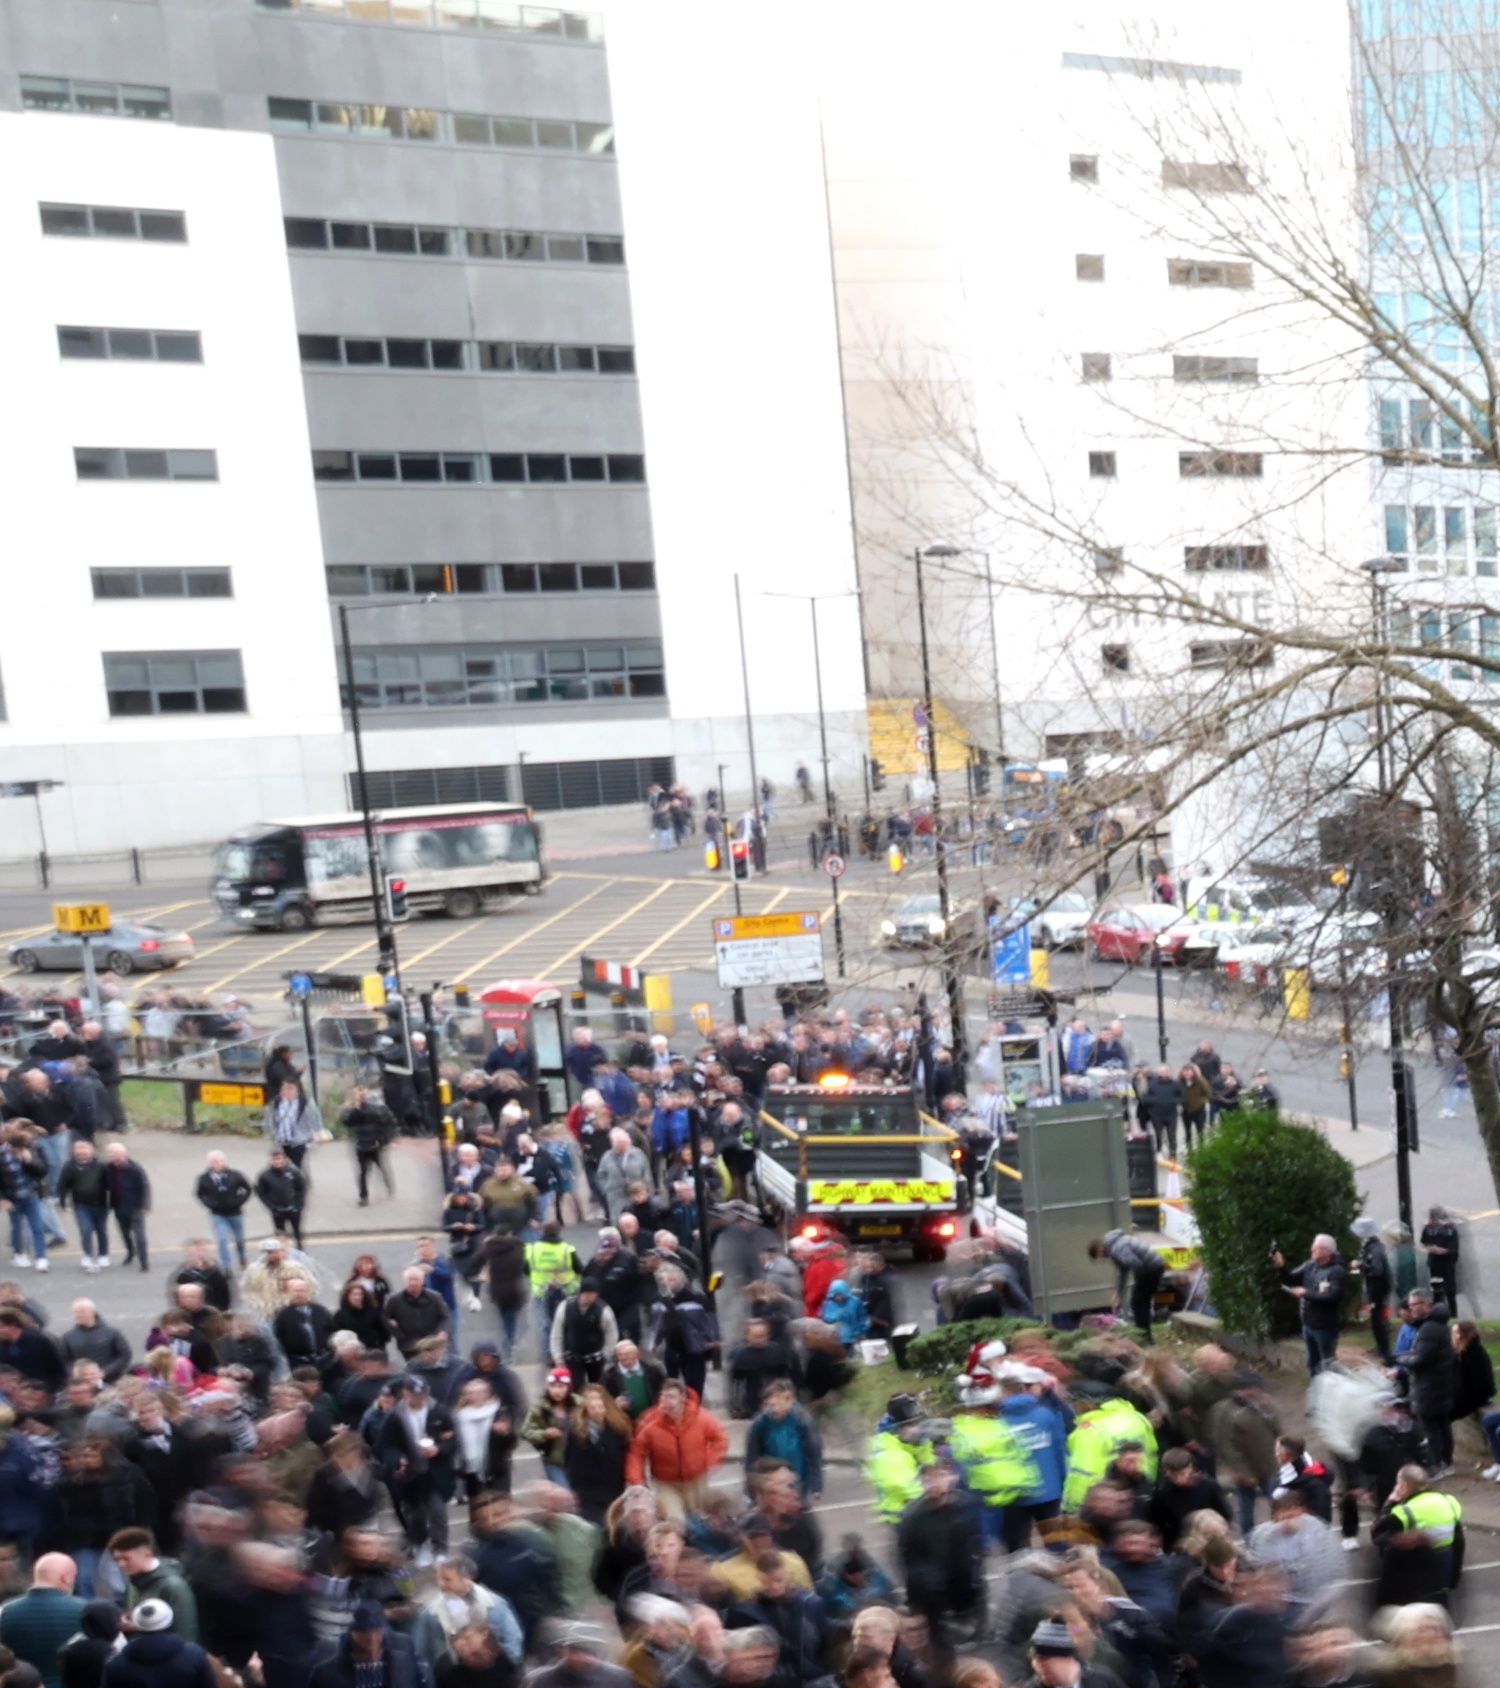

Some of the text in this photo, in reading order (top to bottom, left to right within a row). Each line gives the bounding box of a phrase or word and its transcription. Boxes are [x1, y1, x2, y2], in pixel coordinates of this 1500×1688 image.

[80, 908, 102, 925] M
[819, 1184, 943, 1199] HIGHWAY MAINTENANCE
